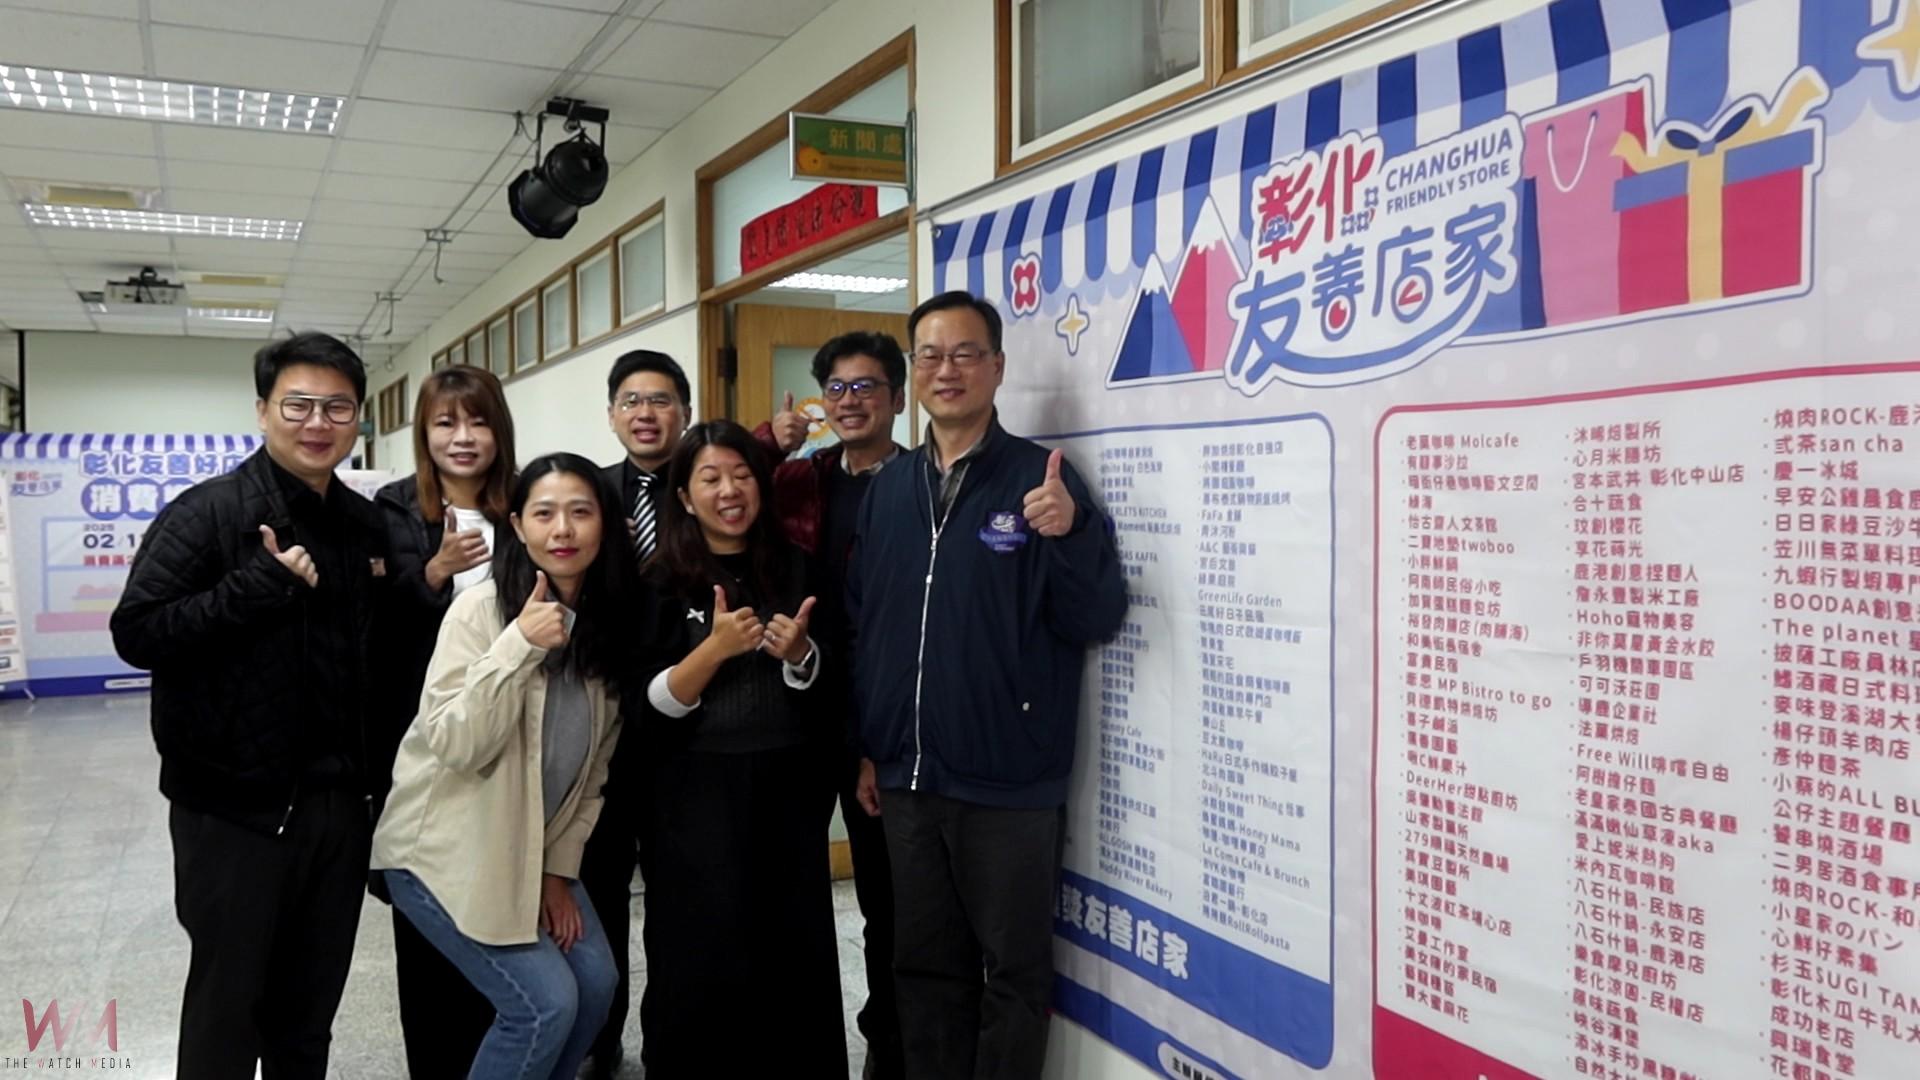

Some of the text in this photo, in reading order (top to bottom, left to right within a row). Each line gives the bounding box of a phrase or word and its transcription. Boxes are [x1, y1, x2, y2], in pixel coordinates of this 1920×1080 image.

[1385, 127, 1513, 192] CHANGHUA
[1386, 158, 1511, 215] FRIENDLY STORE
[1231, 201, 1506, 384] 友善店家
[1864, 433, 1904, 452] cha
[1572, 464, 1745, 490] 宮本武丼 彰化中山店
[1574, 563, 1699, 583] 鹿港創意捏麵人
[1246, 595, 1282, 609] Garden
[1774, 592, 1920, 623] BOODAA創意
[1577, 609, 1695, 632] Hoho寵物美容
[1772, 618, 1814, 637] The
[1823, 623, 1899, 647] planet
[1577, 631, 1715, 657] 非你莫屬黃金水餃
[1438, 677, 1457, 693] MP
[1462, 681, 1503, 701] Bistro
[1510, 690, 1526, 705] to
[1531, 696, 1552, 711] go
[1774, 695, 1920, 734] 麥味登溪湖大
[1577, 743, 1612, 764] Free
[1202, 778, 1223, 797] Daily
[1226, 785, 1254, 805] Sweet
[1258, 794, 1283, 815] Thing
[1575, 788, 1738, 835] 老皇家泰國古典餐廳
[1240, 820, 1269, 842] Honey
[1271, 831, 1301, 852] Mama
[1773, 798, 1911, 844] 公仔主題餐廳
[1242, 853, 1261, 870] Cafe
[1274, 868, 1311, 890] Brunch
[1055, 882, 1188, 980] 獎友善店家
[1771, 1005, 1854, 1050] 成功老店
